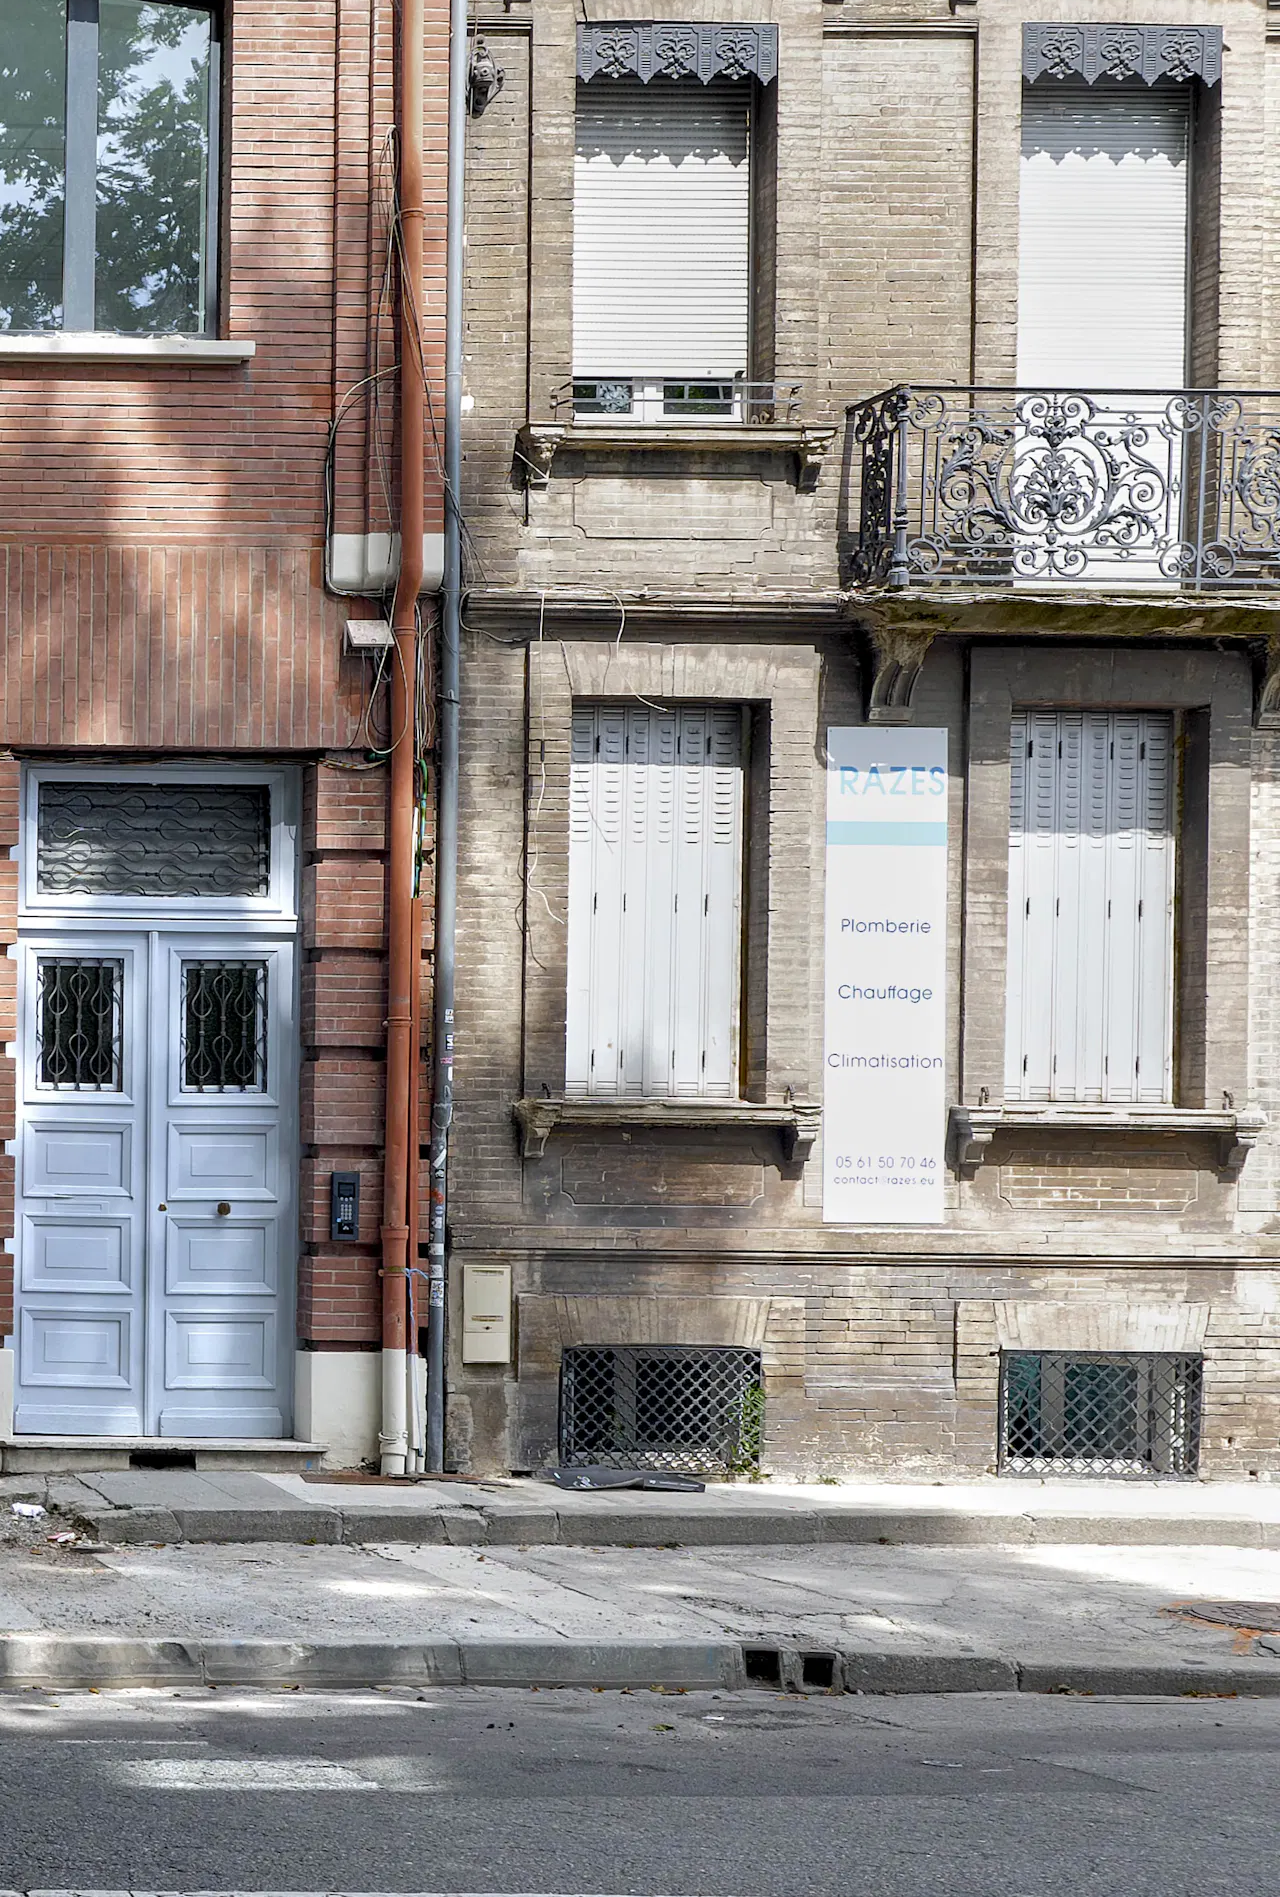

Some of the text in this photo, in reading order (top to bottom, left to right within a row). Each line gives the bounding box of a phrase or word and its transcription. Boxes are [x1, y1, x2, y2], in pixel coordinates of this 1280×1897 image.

[840, 766, 945, 795] RAZES
[841, 918, 931, 933] Plomberie
[838, 985, 932, 1003] Chauffage
[828, 1053, 943, 1068] Climatisation
[835, 1155, 936, 1169] 05 61 50 70 46
